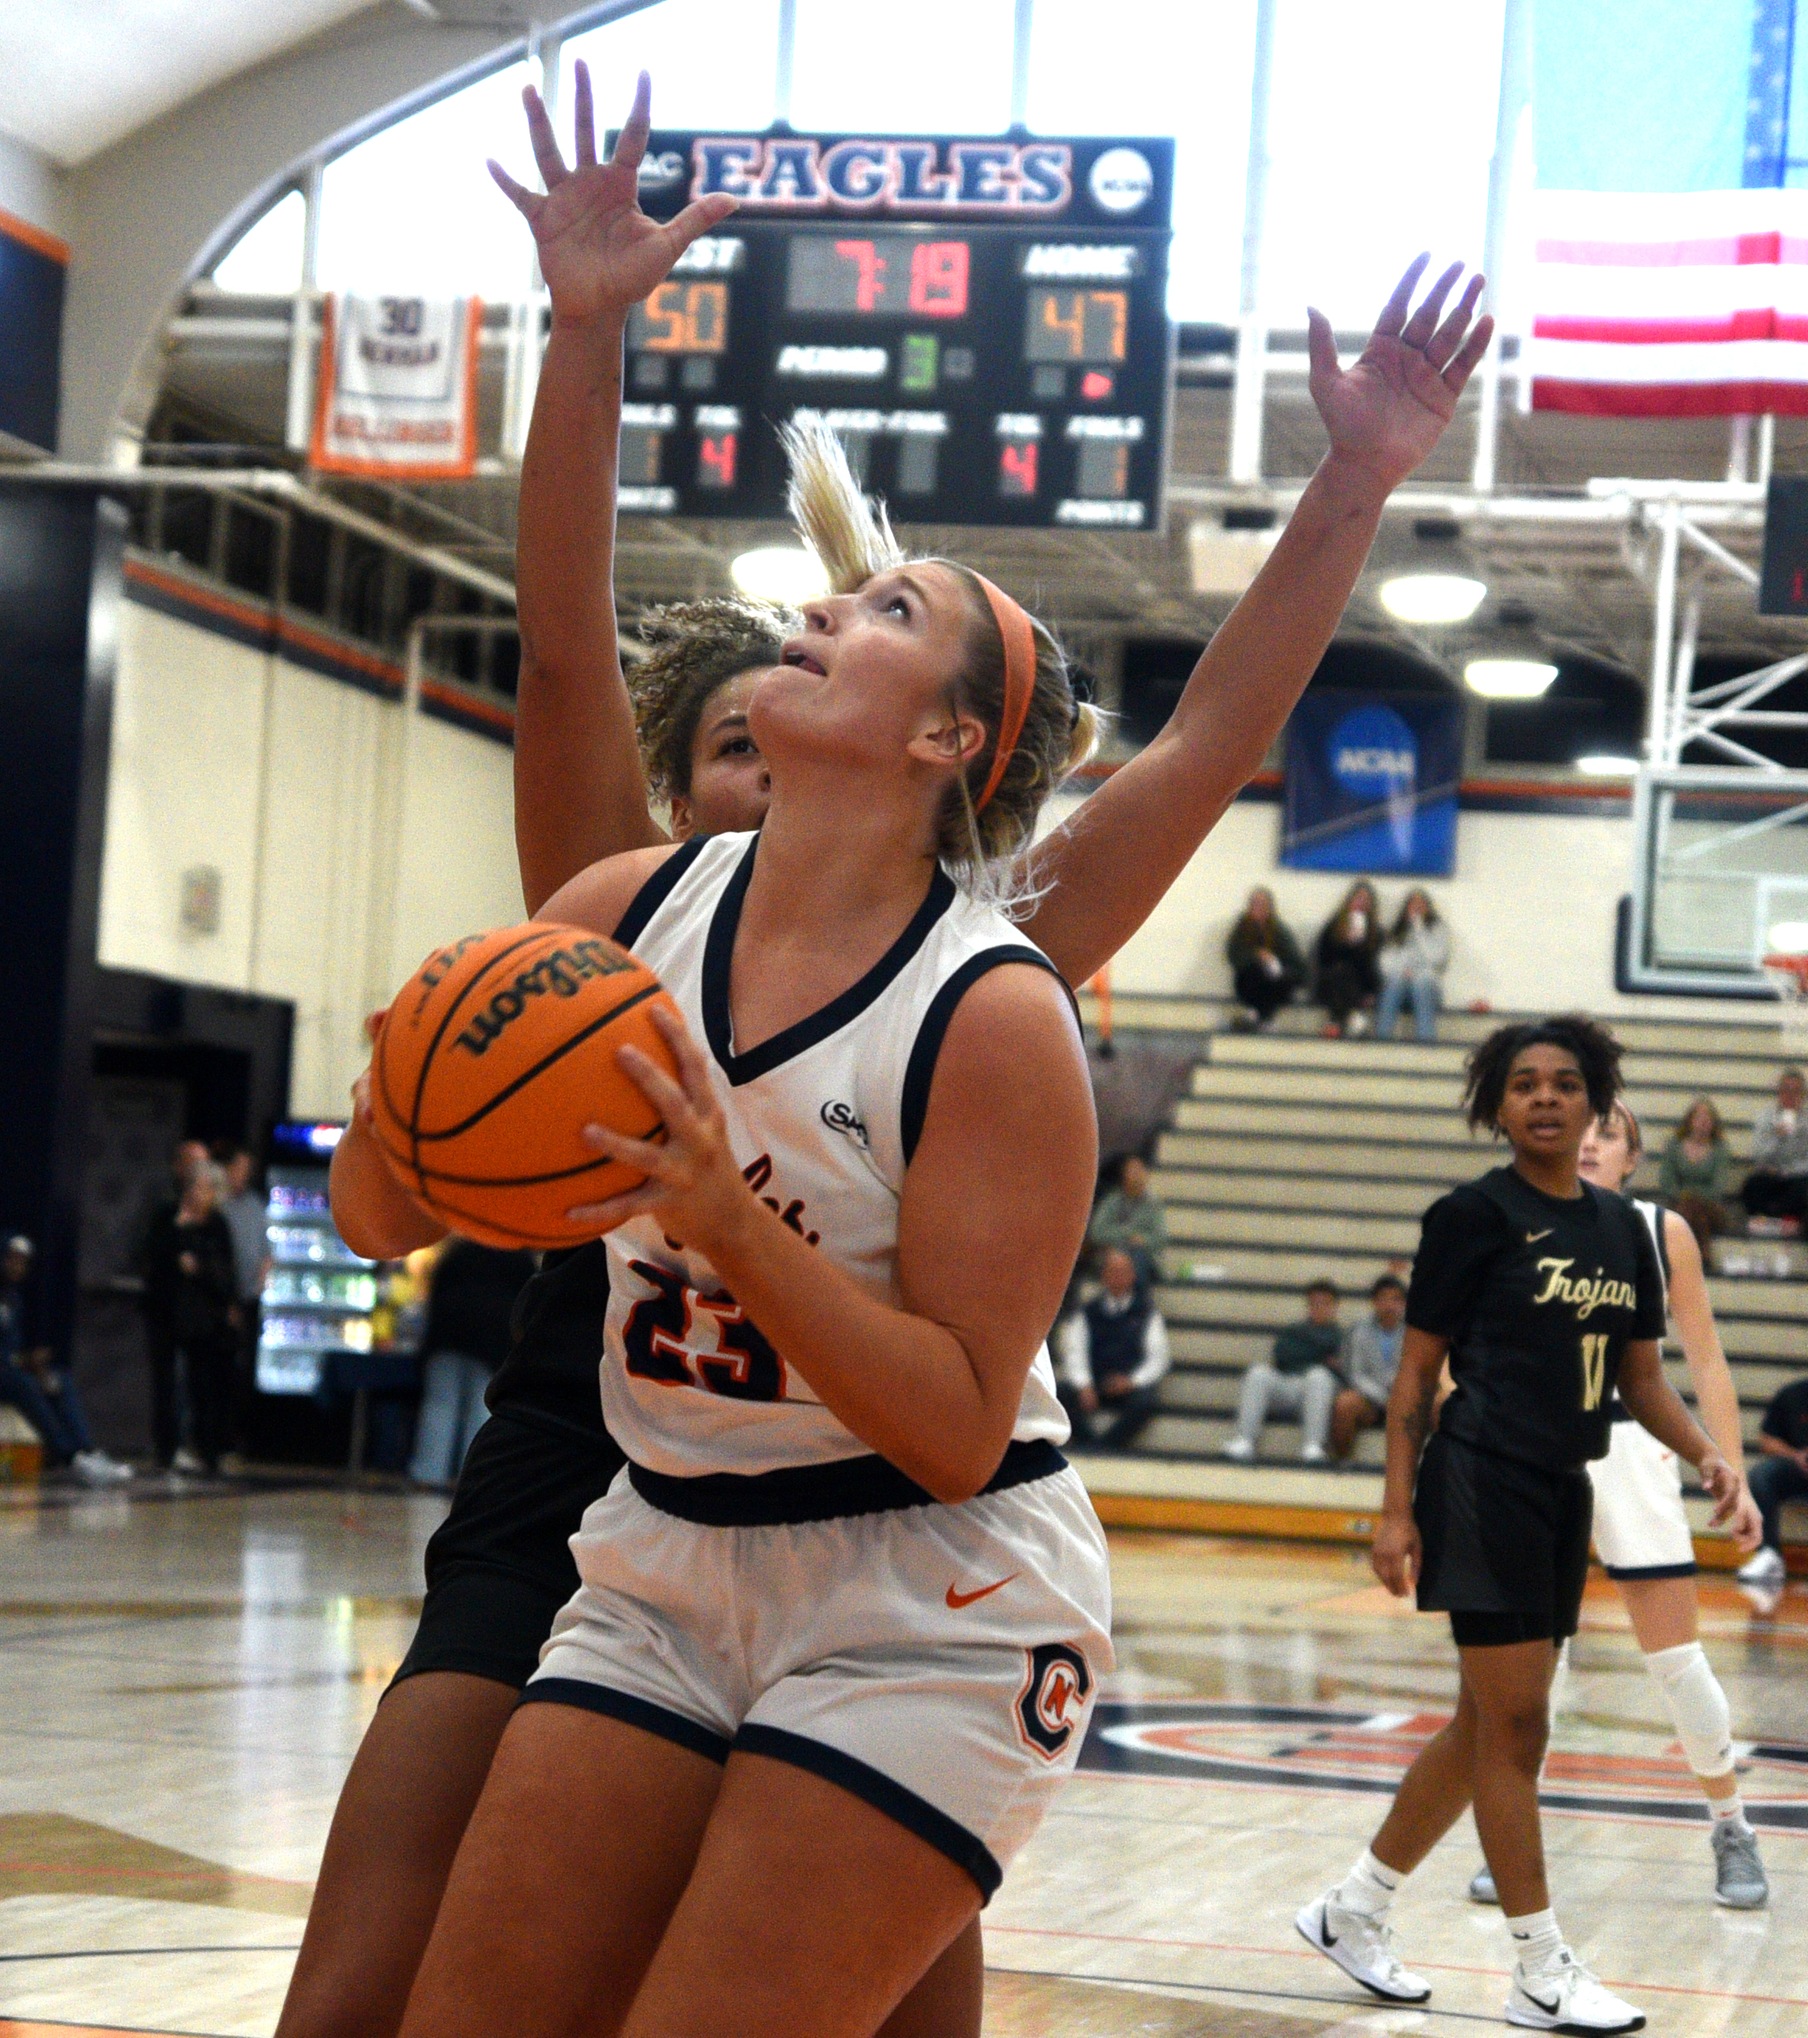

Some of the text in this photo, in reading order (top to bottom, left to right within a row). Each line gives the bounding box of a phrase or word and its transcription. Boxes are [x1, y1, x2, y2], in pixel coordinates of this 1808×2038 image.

[637, 150, 684, 177] AC
[691, 138, 1072, 213] EAGLES
[645, 282, 727, 353] 50
[1044, 291, 1128, 363] 47
[903, 334, 938, 391] 3
[702, 434, 737, 487] 4
[1003, 442, 1038, 494] 4
[451, 940, 637, 1056] Wilson
[622, 1259, 788, 1402] 23
